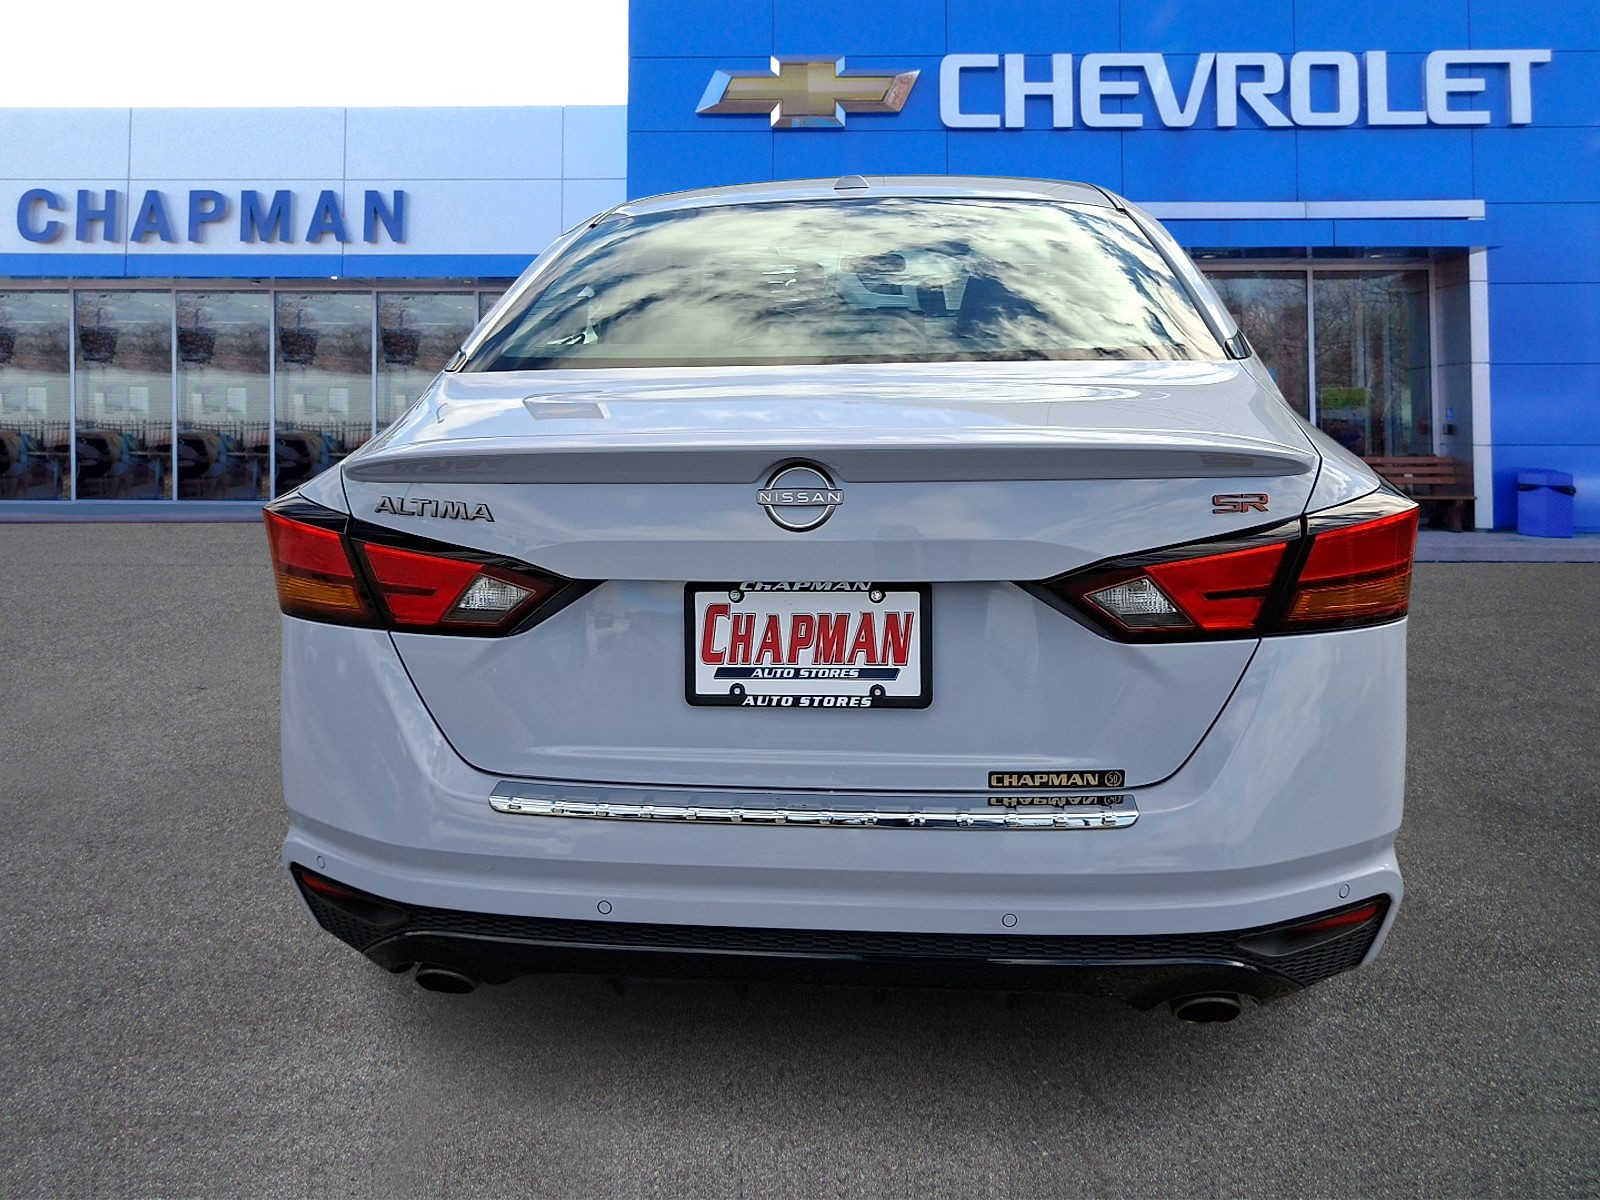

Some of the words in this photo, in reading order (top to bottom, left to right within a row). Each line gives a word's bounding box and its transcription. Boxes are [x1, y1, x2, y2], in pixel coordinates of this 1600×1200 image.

[939, 49, 1552, 129] CHEVROLET
[16, 188, 409, 243] CHAPMAN
[759, 492, 841, 503] NISSAN
[1212, 494, 1268, 513] SR
[375, 496, 495, 522] ALTIMA
[739, 581, 872, 591] CHAPMAN
[701, 603, 914, 666] CHAPMAN
[751, 669, 794, 678] AUTO
[800, 669, 859, 678] STORES
[742, 696, 793, 706] AUTO
[799, 697, 872, 707] STORES
[991, 774, 1098, 786] CHAPMAN
